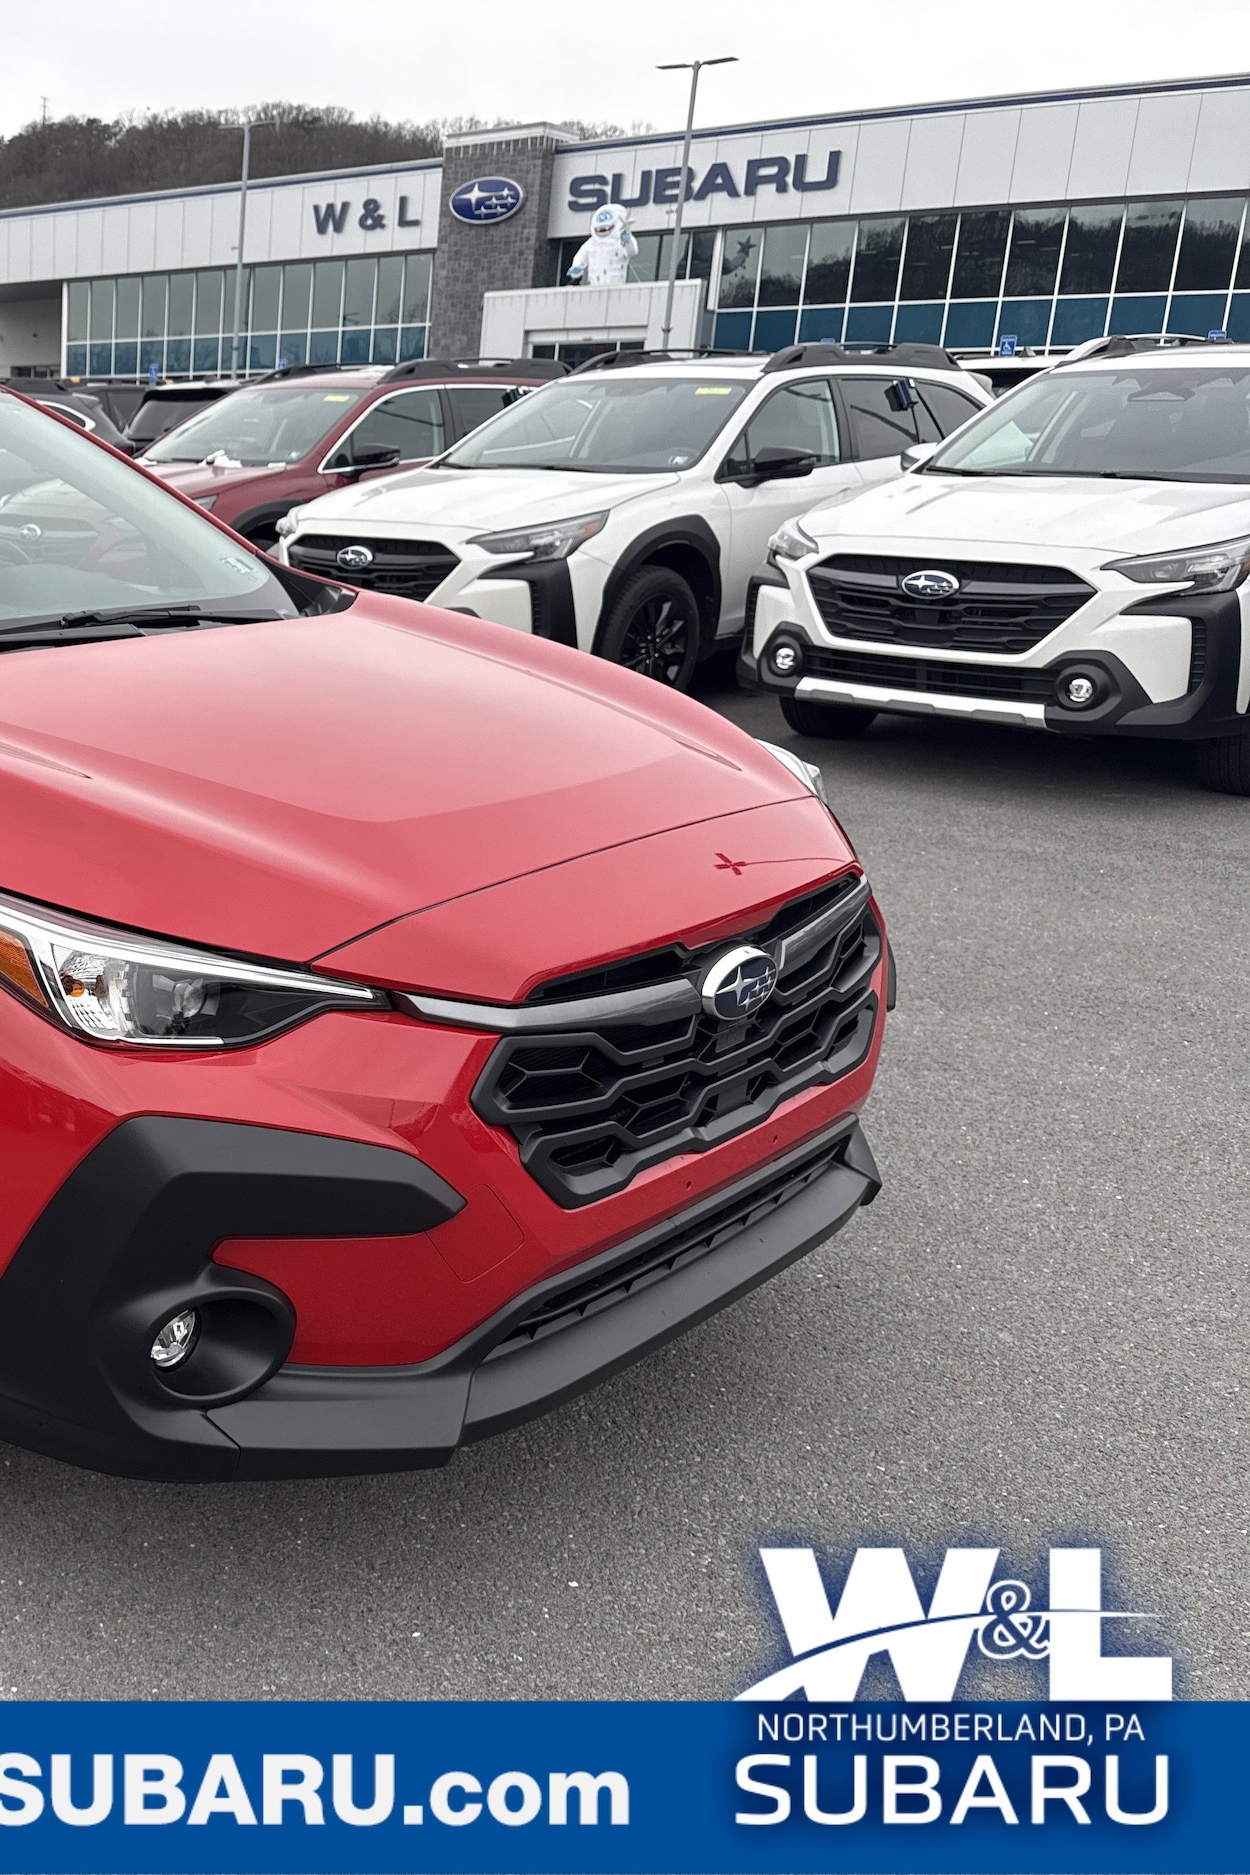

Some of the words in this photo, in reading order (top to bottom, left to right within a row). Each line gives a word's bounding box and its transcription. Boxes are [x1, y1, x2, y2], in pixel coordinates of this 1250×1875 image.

[568, 150, 841, 212] SUBARU
[312, 201, 351, 235] W
[358, 198, 386, 231] &
[397, 195, 420, 228] L
